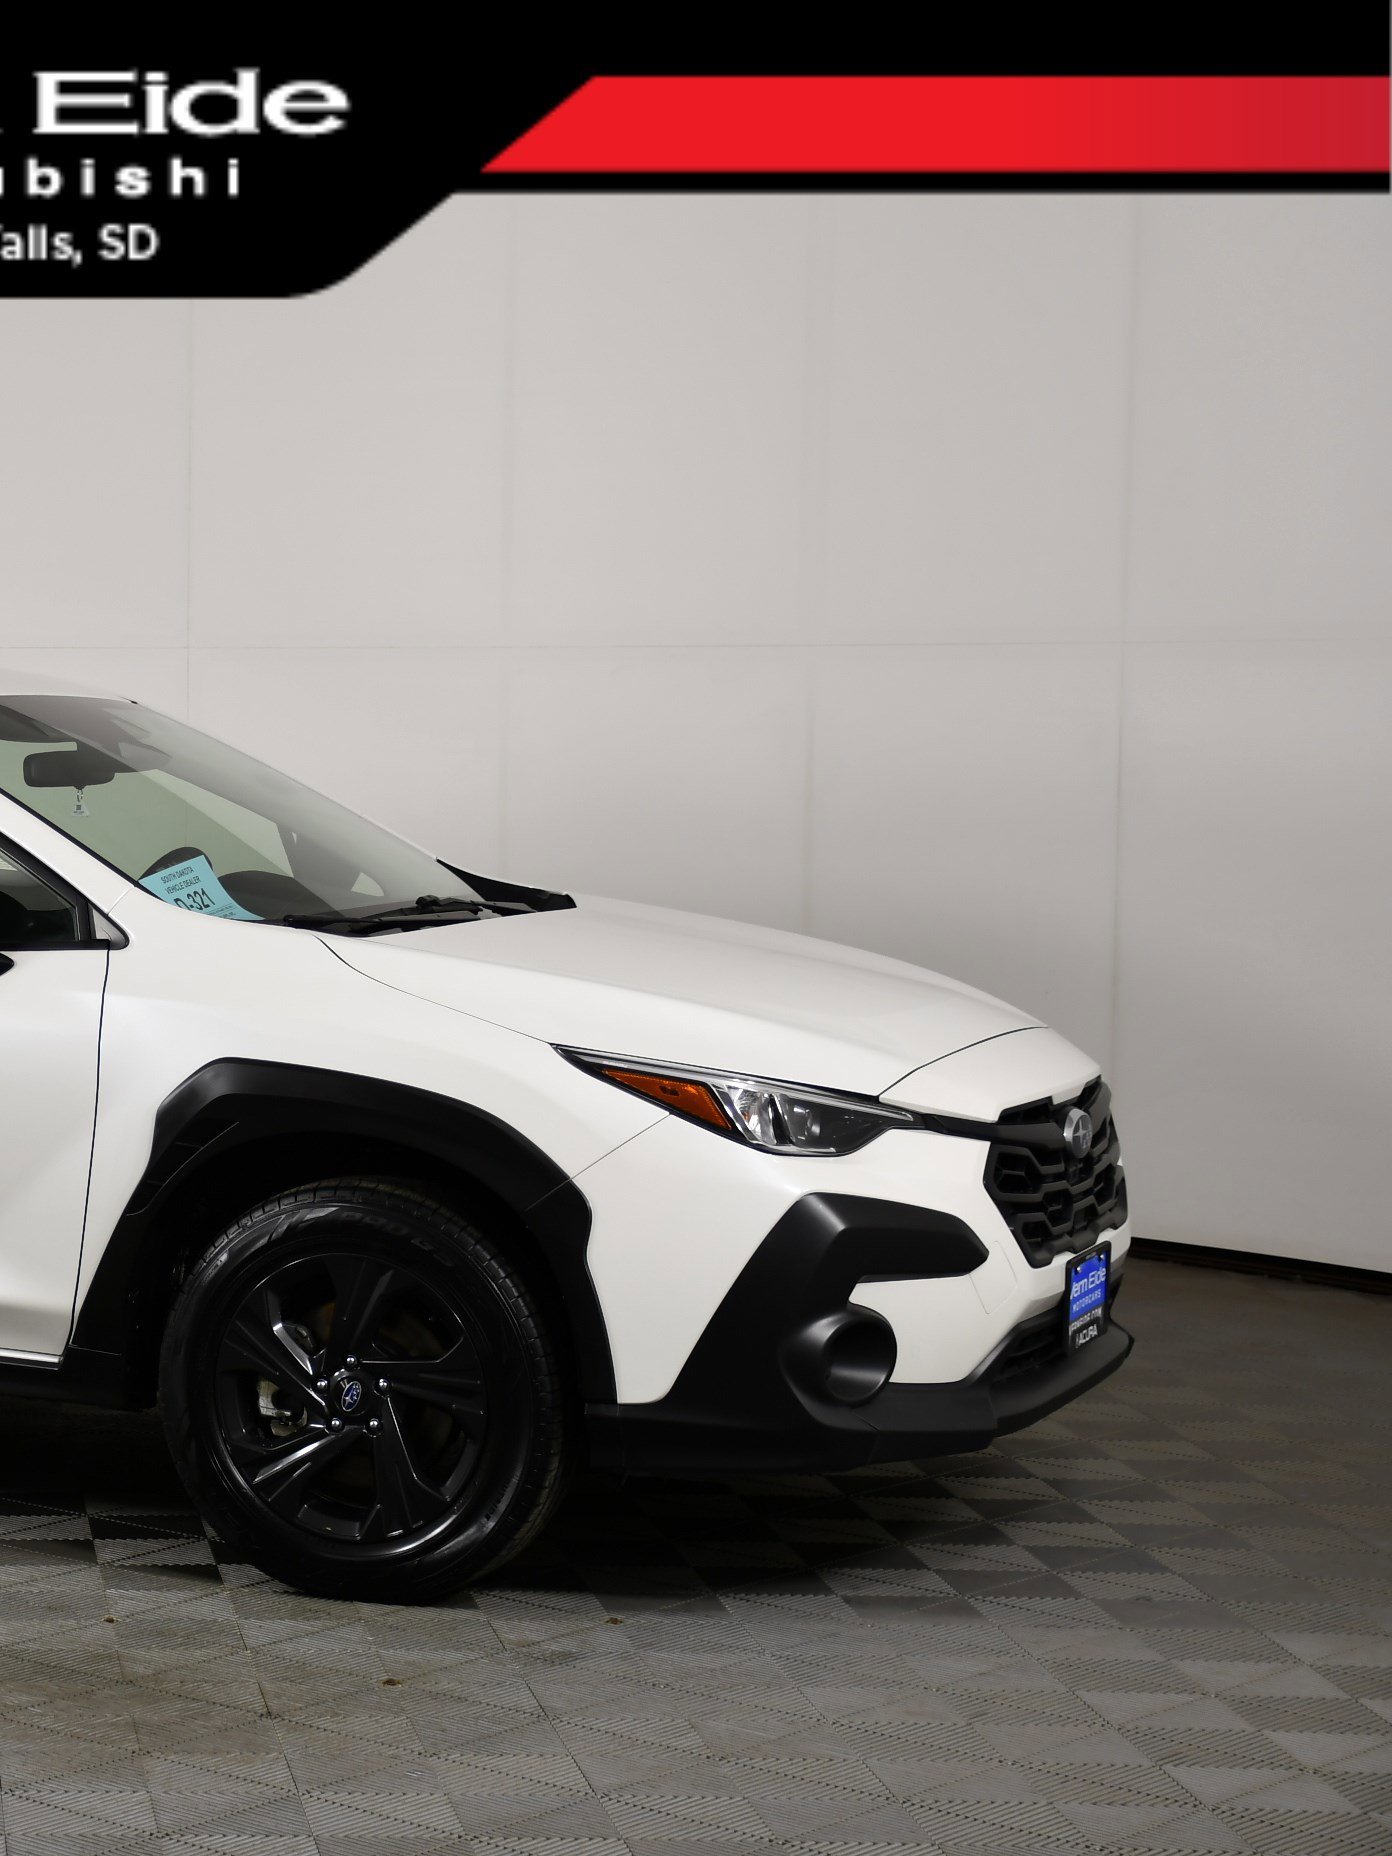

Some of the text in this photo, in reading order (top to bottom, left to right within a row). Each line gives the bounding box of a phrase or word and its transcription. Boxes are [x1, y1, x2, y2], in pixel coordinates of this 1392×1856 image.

[161, 867, 194, 884] SOUTH DAKOTA
[165, 876, 201, 894] VEHICLE DEALER
[1089, 1266, 1106, 1288] Eide
[1073, 1289, 1101, 1312] MOTORCARS
